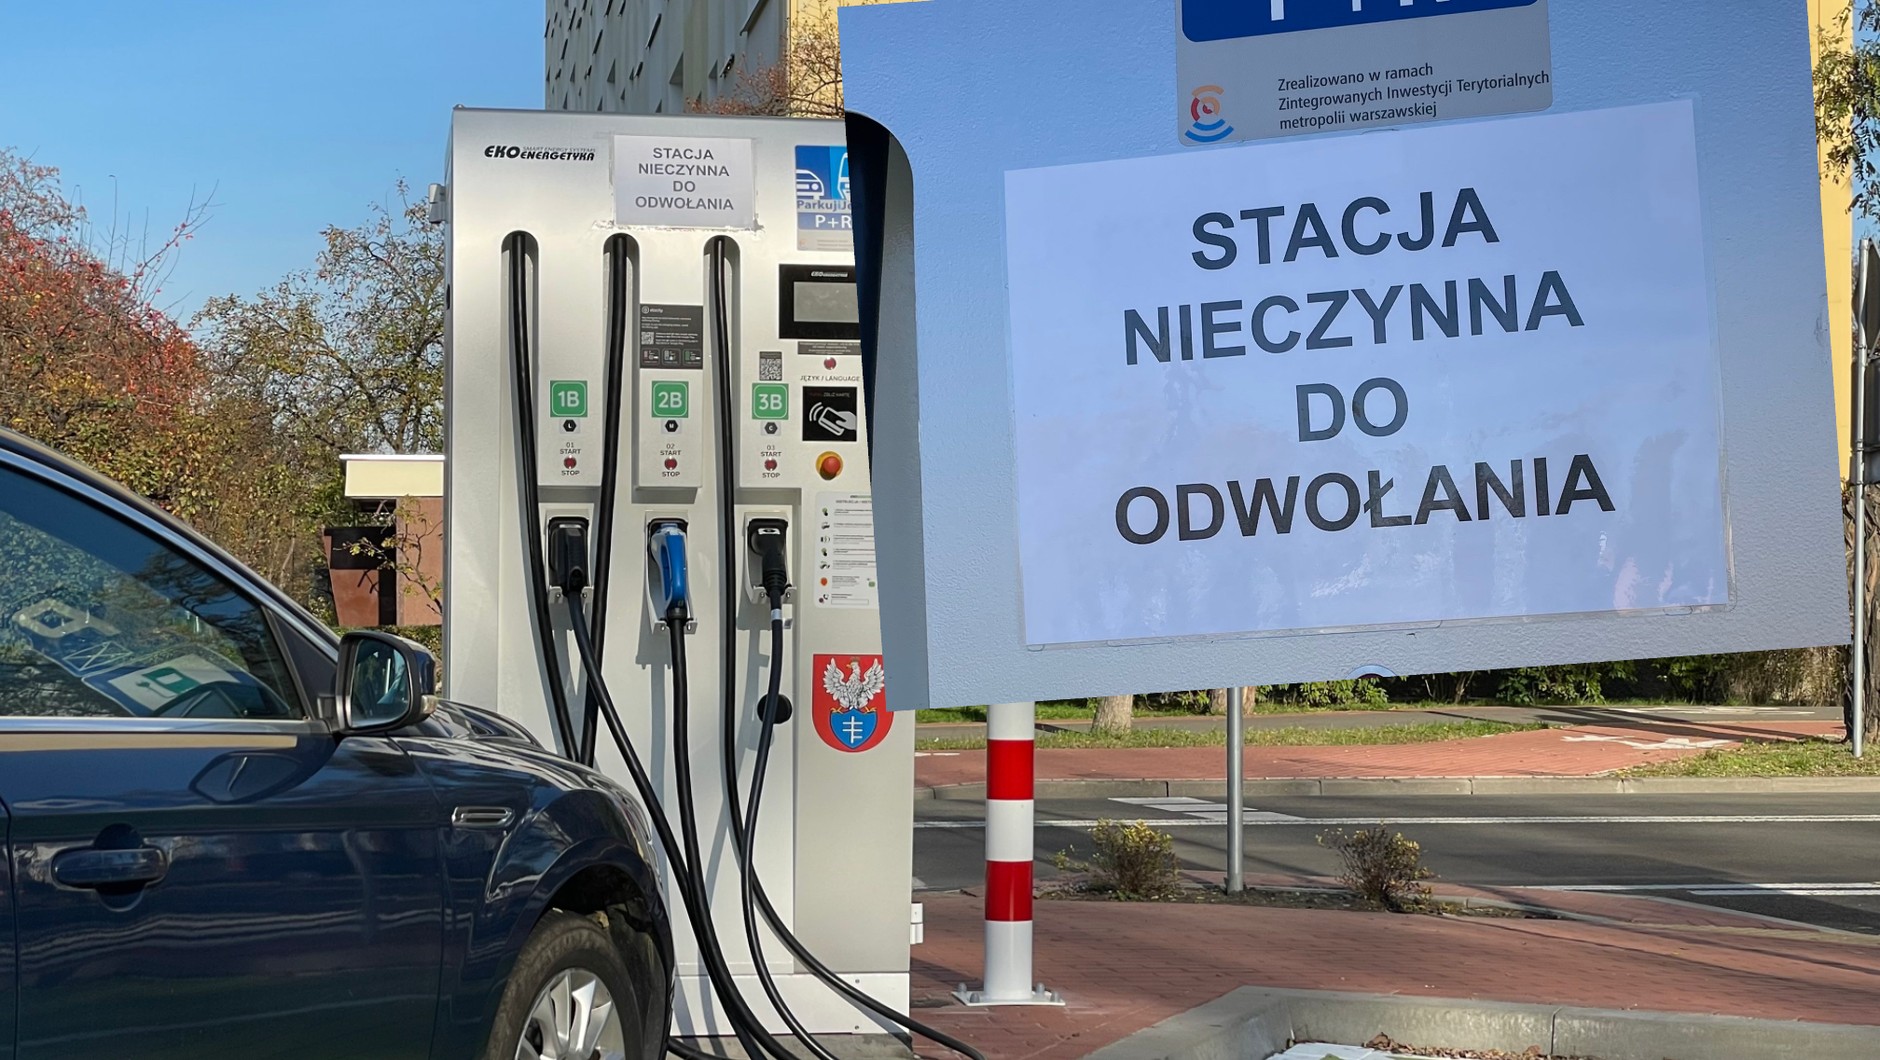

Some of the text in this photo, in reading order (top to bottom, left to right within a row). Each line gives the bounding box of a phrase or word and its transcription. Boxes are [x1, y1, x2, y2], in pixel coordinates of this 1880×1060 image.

[1278, 63, 1433, 92] Zrealizowano w ramach
[1278, 70, 1550, 111] Zintegrowanych Inwestycji Terytorialnych
[1280, 102, 1437, 130] metropolii warszawskiej
[653, 147, 714, 160] STACJA
[638, 163, 730, 177] NIECZYNNA
[673, 180, 696, 193] DO
[635, 196, 734, 211] ODWOŁANIA
[1191, 187, 1499, 270] STACJA
[1124, 270, 1584, 366] NIECZYNNA
[558, 390, 580, 408] 1B
[658, 391, 683, 409] 2B
[758, 393, 783, 411] 3B
[1295, 377, 1409, 443] DO
[1115, 454, 1616, 545] ODWOŁANIA
